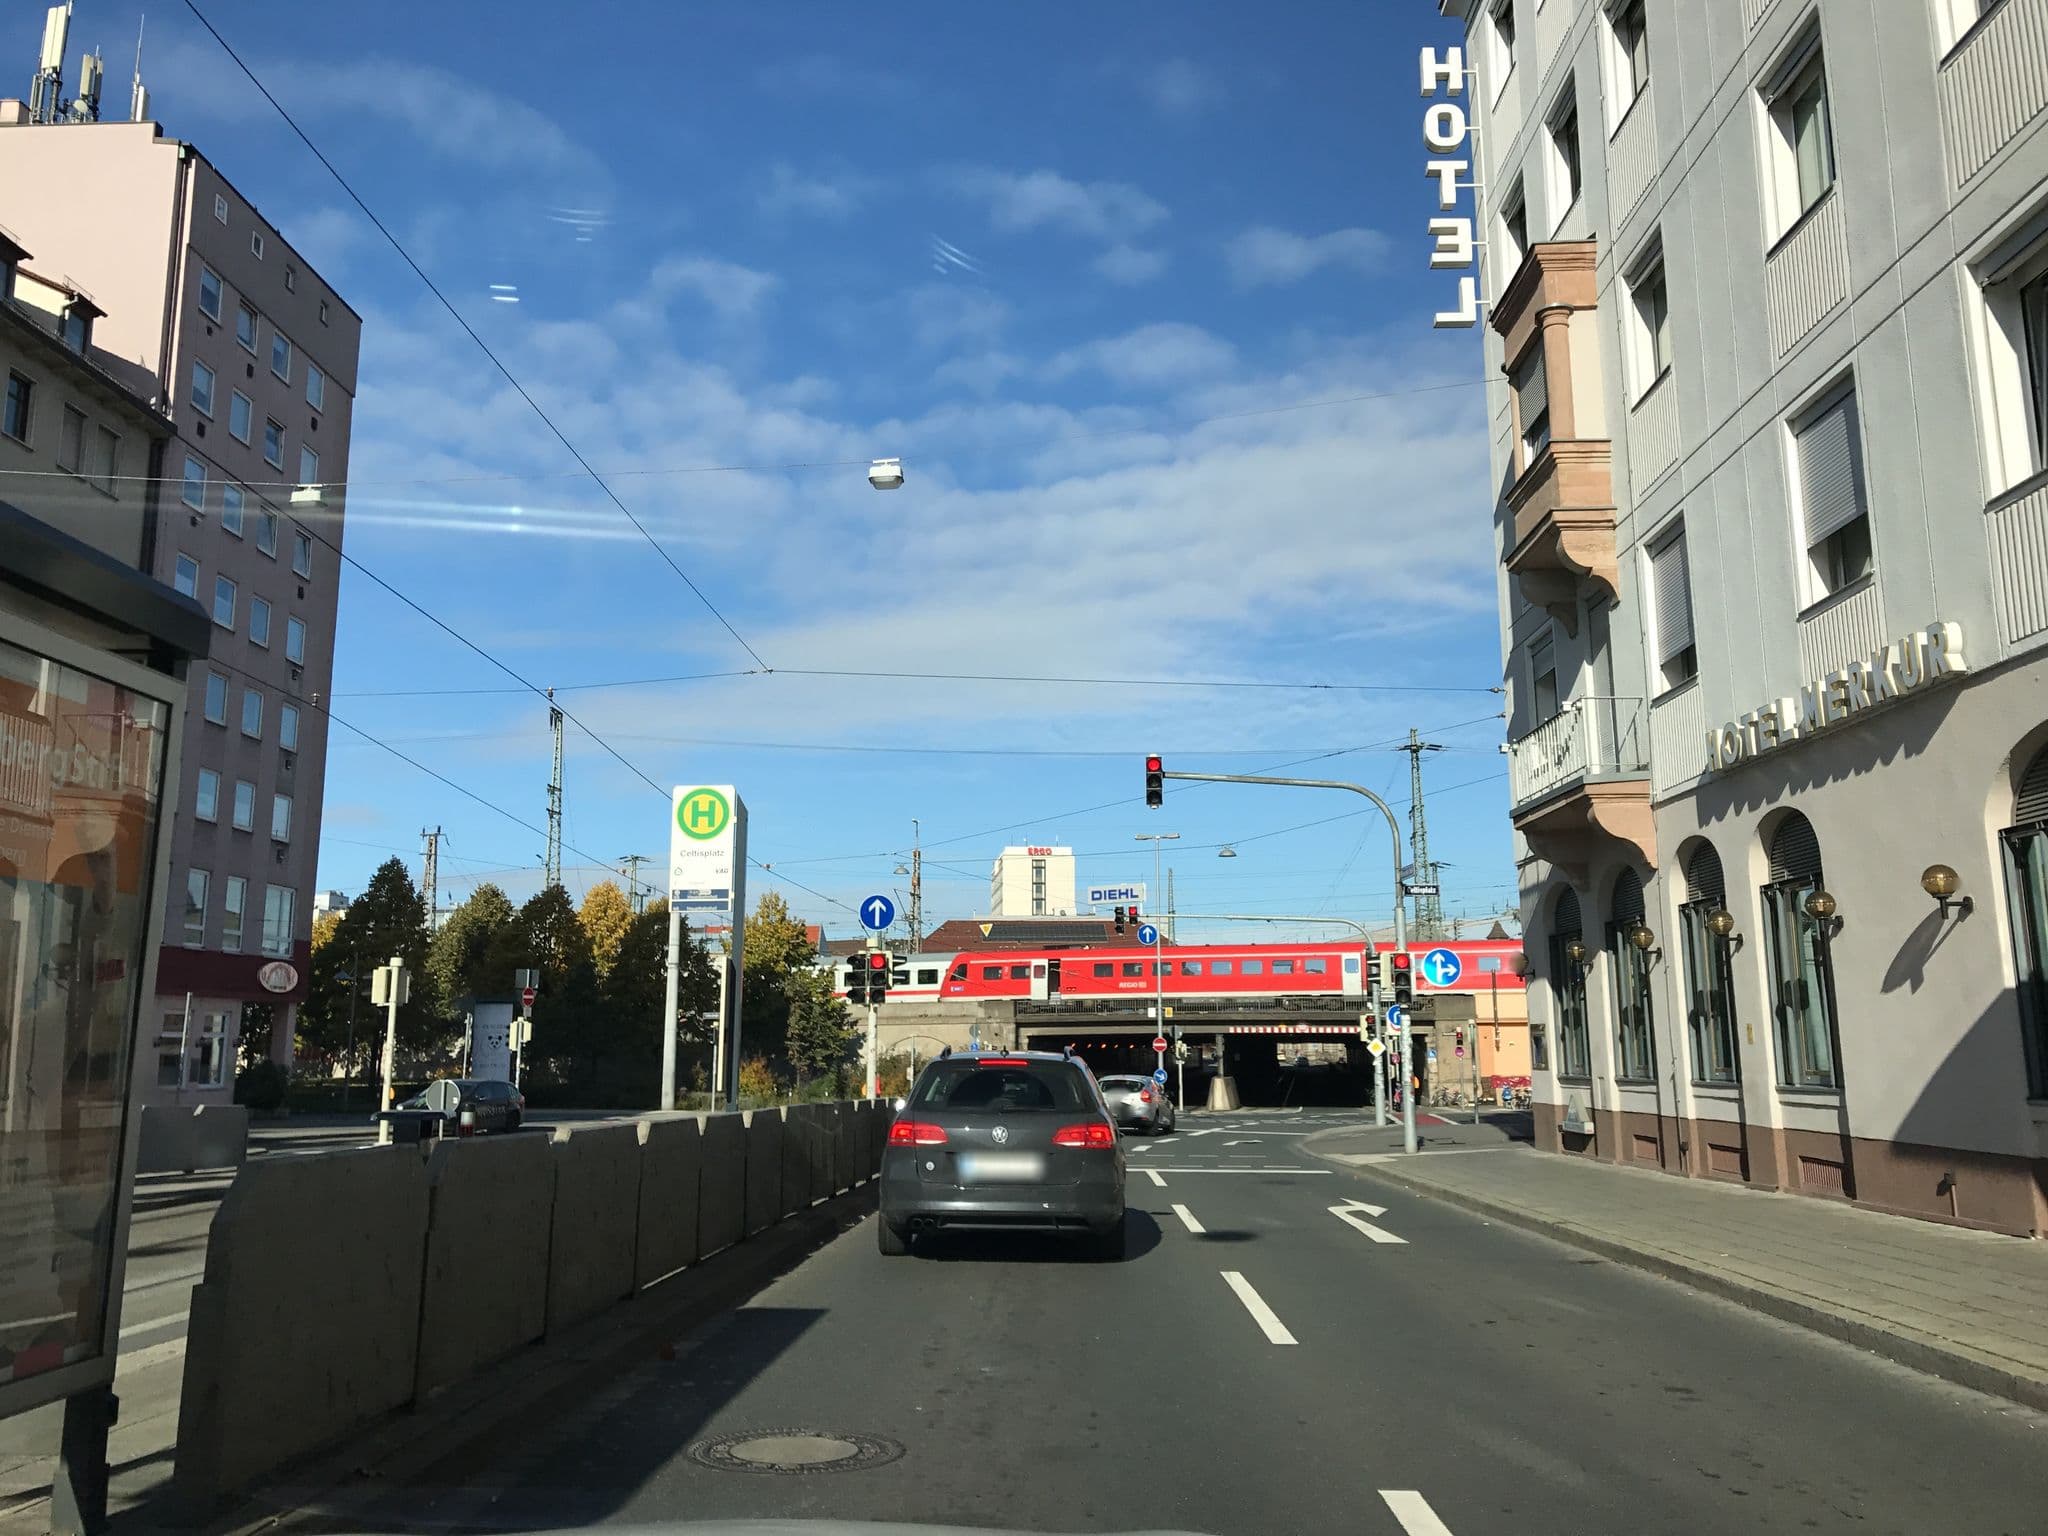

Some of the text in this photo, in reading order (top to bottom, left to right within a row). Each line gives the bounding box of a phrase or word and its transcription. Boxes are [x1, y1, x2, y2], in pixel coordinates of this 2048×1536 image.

[1705, 621, 1968, 773] HOTEL MERKUR
[690, 799, 717, 829] H
[680, 848, 726, 859] Celtisplatz
[1028, 847, 1053, 857] ERGO
[1090, 887, 1140, 902] DIEHL
